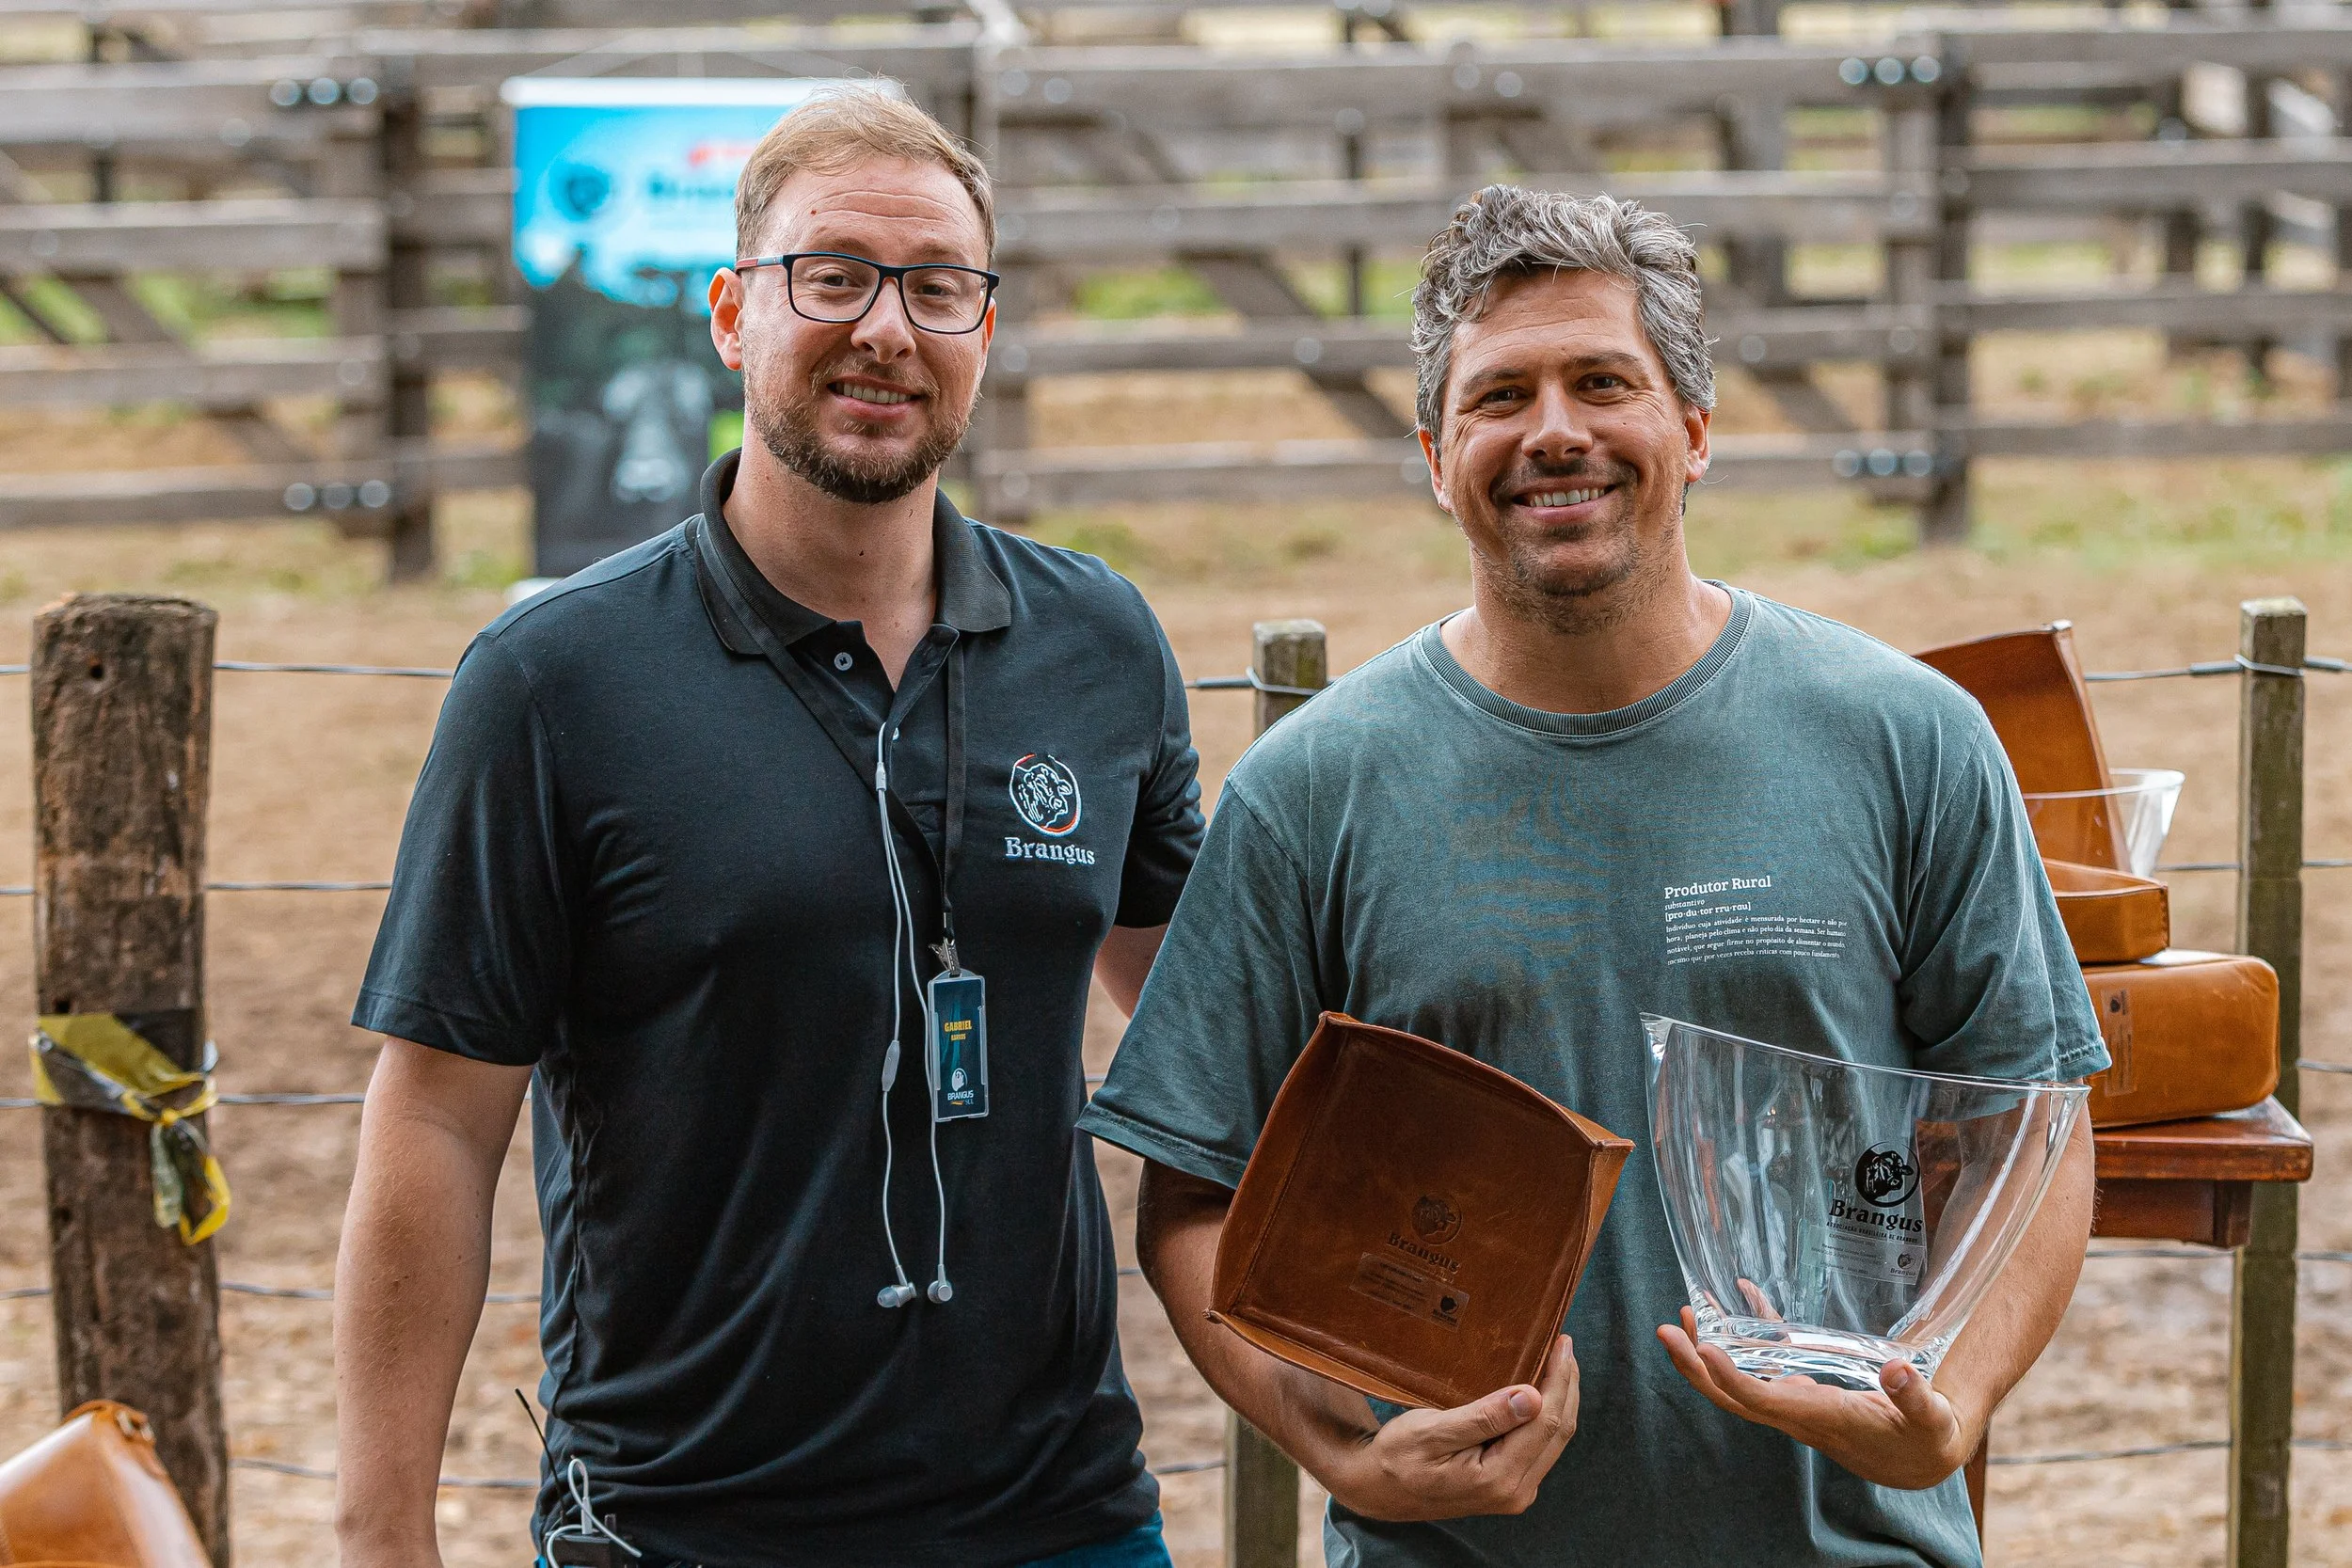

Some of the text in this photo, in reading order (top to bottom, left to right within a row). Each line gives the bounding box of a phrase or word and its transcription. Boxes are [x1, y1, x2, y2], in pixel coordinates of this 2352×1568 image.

[1004, 837, 1095, 864] Brangus
[1664, 875, 1772, 899] Produtor Rural
[1664, 899, 1705, 911] substantivo
[1714, 916, 1742, 926] atividade
[1750, 914, 1785, 923] mensurada
[1786, 916, 1798, 925] por
[1799, 915, 1821, 925] hectare
[1684, 932, 1708, 942] planeja
[1708, 928, 1723, 940] pelo
[1723, 927, 1741, 936] clima
[1759, 925, 1774, 935] pelo
[1785, 925, 1792, 933] da
[1692, 944, 1706, 953] que
[1707, 942, 1724, 951] segue
[1787, 936, 1795, 944] de
[1691, 955, 1703, 964] que
[1704, 953, 1715, 962] por
[1734, 947, 1755, 957] receba
[1793, 949, 1811, 958] pouco
[945, 1020, 972, 1032] GABRIEL
[947, 1090, 974, 1101] BRANGUS
[1828, 1198, 1924, 1231] Brangus
[1389, 1231, 1460, 1274] Brangus
